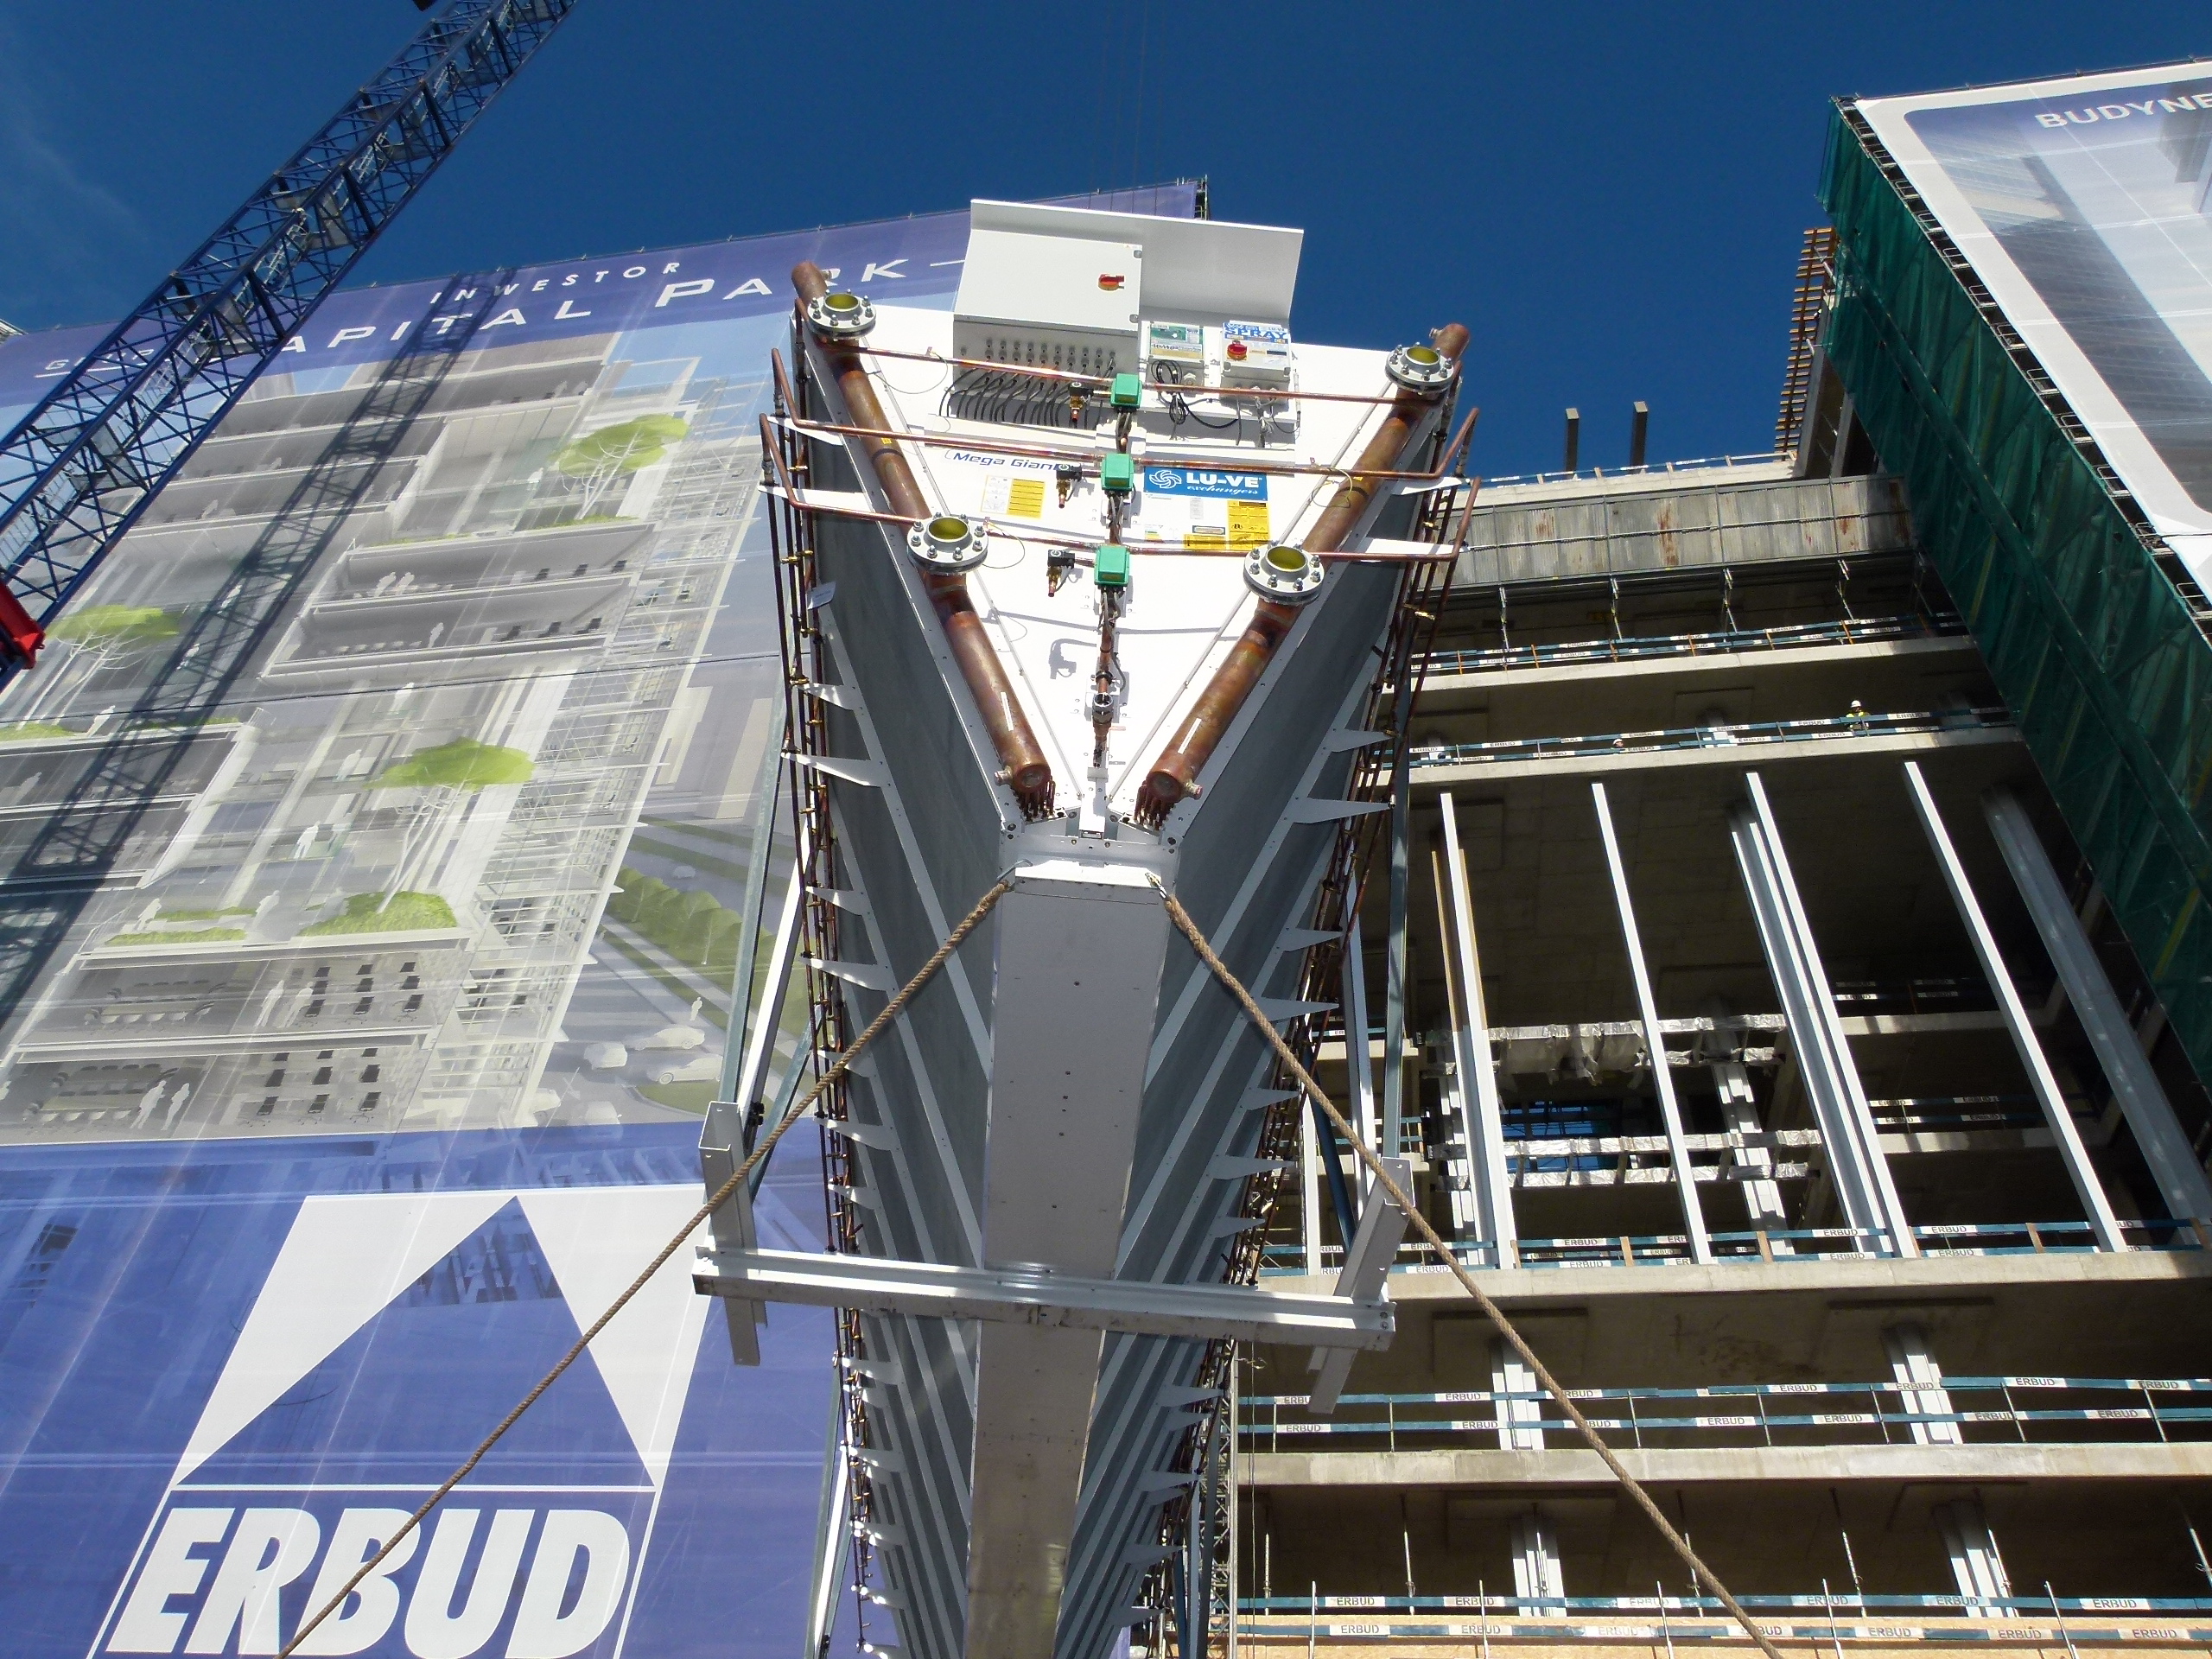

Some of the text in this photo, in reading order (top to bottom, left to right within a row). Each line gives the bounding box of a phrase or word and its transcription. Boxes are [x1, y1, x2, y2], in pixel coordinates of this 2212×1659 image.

[2035, 93, 2212, 129] BUDYNE
[430, 262, 681, 304] INWESTOR
[283, 300, 592, 353] APITAL
[953, 452, 1058, 471] Mega Gian
[1186, 472, 1260, 488] LU-VE
[1823, 1229, 1859, 1237] ERBUD
[1931, 1225, 1967, 1234] ERBUD
[1569, 1260, 1604, 1268] ERBUD
[1416, 1265, 1450, 1274] ERBUD
[1896, 1382, 1935, 1390] ERBUD
[2016, 1377, 2056, 1386] ERBUD
[2138, 1380, 2179, 1389] ERBUD
[1780, 1384, 1818, 1393] ERBUD
[1446, 1392, 1482, 1402] ERBUD
[1565, 1389, 1593, 1398] RBUD
[2098, 1409, 2139, 1418] ERBUD
[1707, 1417, 1745, 1426] ERBUD
[1824, 1414, 1863, 1423] ERBUD
[1286, 1424, 1321, 1433] ERBUD
[1462, 1421, 1498, 1430] ERBUD
[105, 1508, 631, 1659] ERBUD
[1337, 1597, 1376, 1605] ERBUD
[1936, 1596, 1979, 1605] ERBUD
[2092, 1599, 2137, 1608] ERBUD
[1340, 1624, 1380, 1634] ERBUD
[1599, 1626, 1639, 1636] ERBUD
[1868, 1628, 1911, 1637] ERBUD
[2132, 1629, 2177, 1638] ERBUD
[1999, 1630, 2042, 1639] ERBUD
